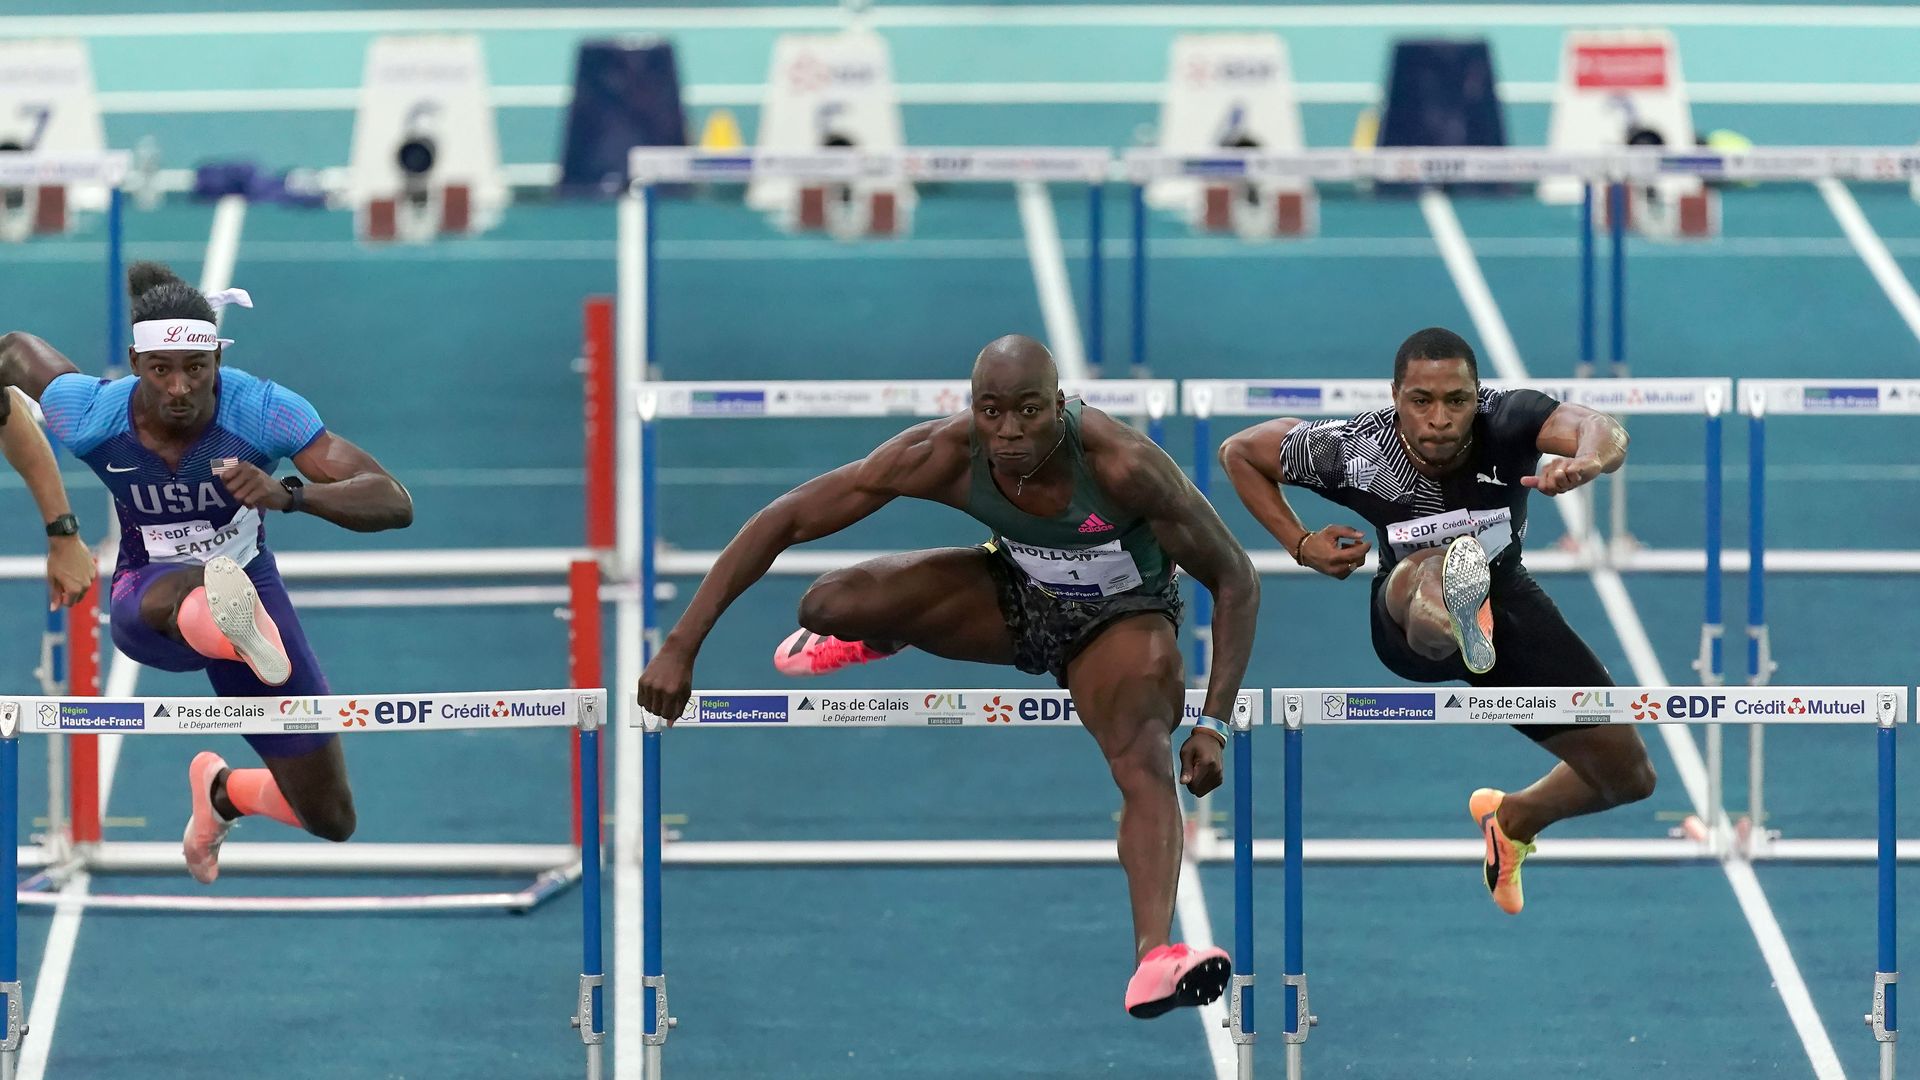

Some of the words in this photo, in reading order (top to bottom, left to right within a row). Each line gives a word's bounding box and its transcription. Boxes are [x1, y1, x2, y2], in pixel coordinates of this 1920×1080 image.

[130, 482, 227, 514] USA
[1078, 524, 1115, 533] adidas
[1442, 518, 1467, 531] Crédit
[174, 528, 240, 554] EATON
[1068, 570, 1080, 580] 1
[702, 700, 729, 709] Région
[822, 699, 846, 710] Pas
[849, 699, 865, 710] de
[868, 699, 909, 710] Calais
[1469, 697, 1493, 708] Pas
[1497, 697, 1512, 708] de
[1516, 696, 1556, 708] Calais
[1735, 699, 1786, 714] Crédit
[1808, 700, 1865, 714] Mutuel
[62, 706, 88, 715] Région
[177, 706, 201, 717] Pas
[205, 706, 220, 717] de
[224, 705, 264, 717] Calais
[441, 704, 490, 718] Crédit
[511, 702, 565, 716] Mutuel
[702, 710, 786, 719] Hauts-de-France
[1349, 708, 1433, 716] Hauts-de-France
[835, 714, 886, 723] Département
[1482, 711, 1534, 720] Département
[62, 717, 143, 726] Hauts-de-France
[190, 720, 242, 730] Département
